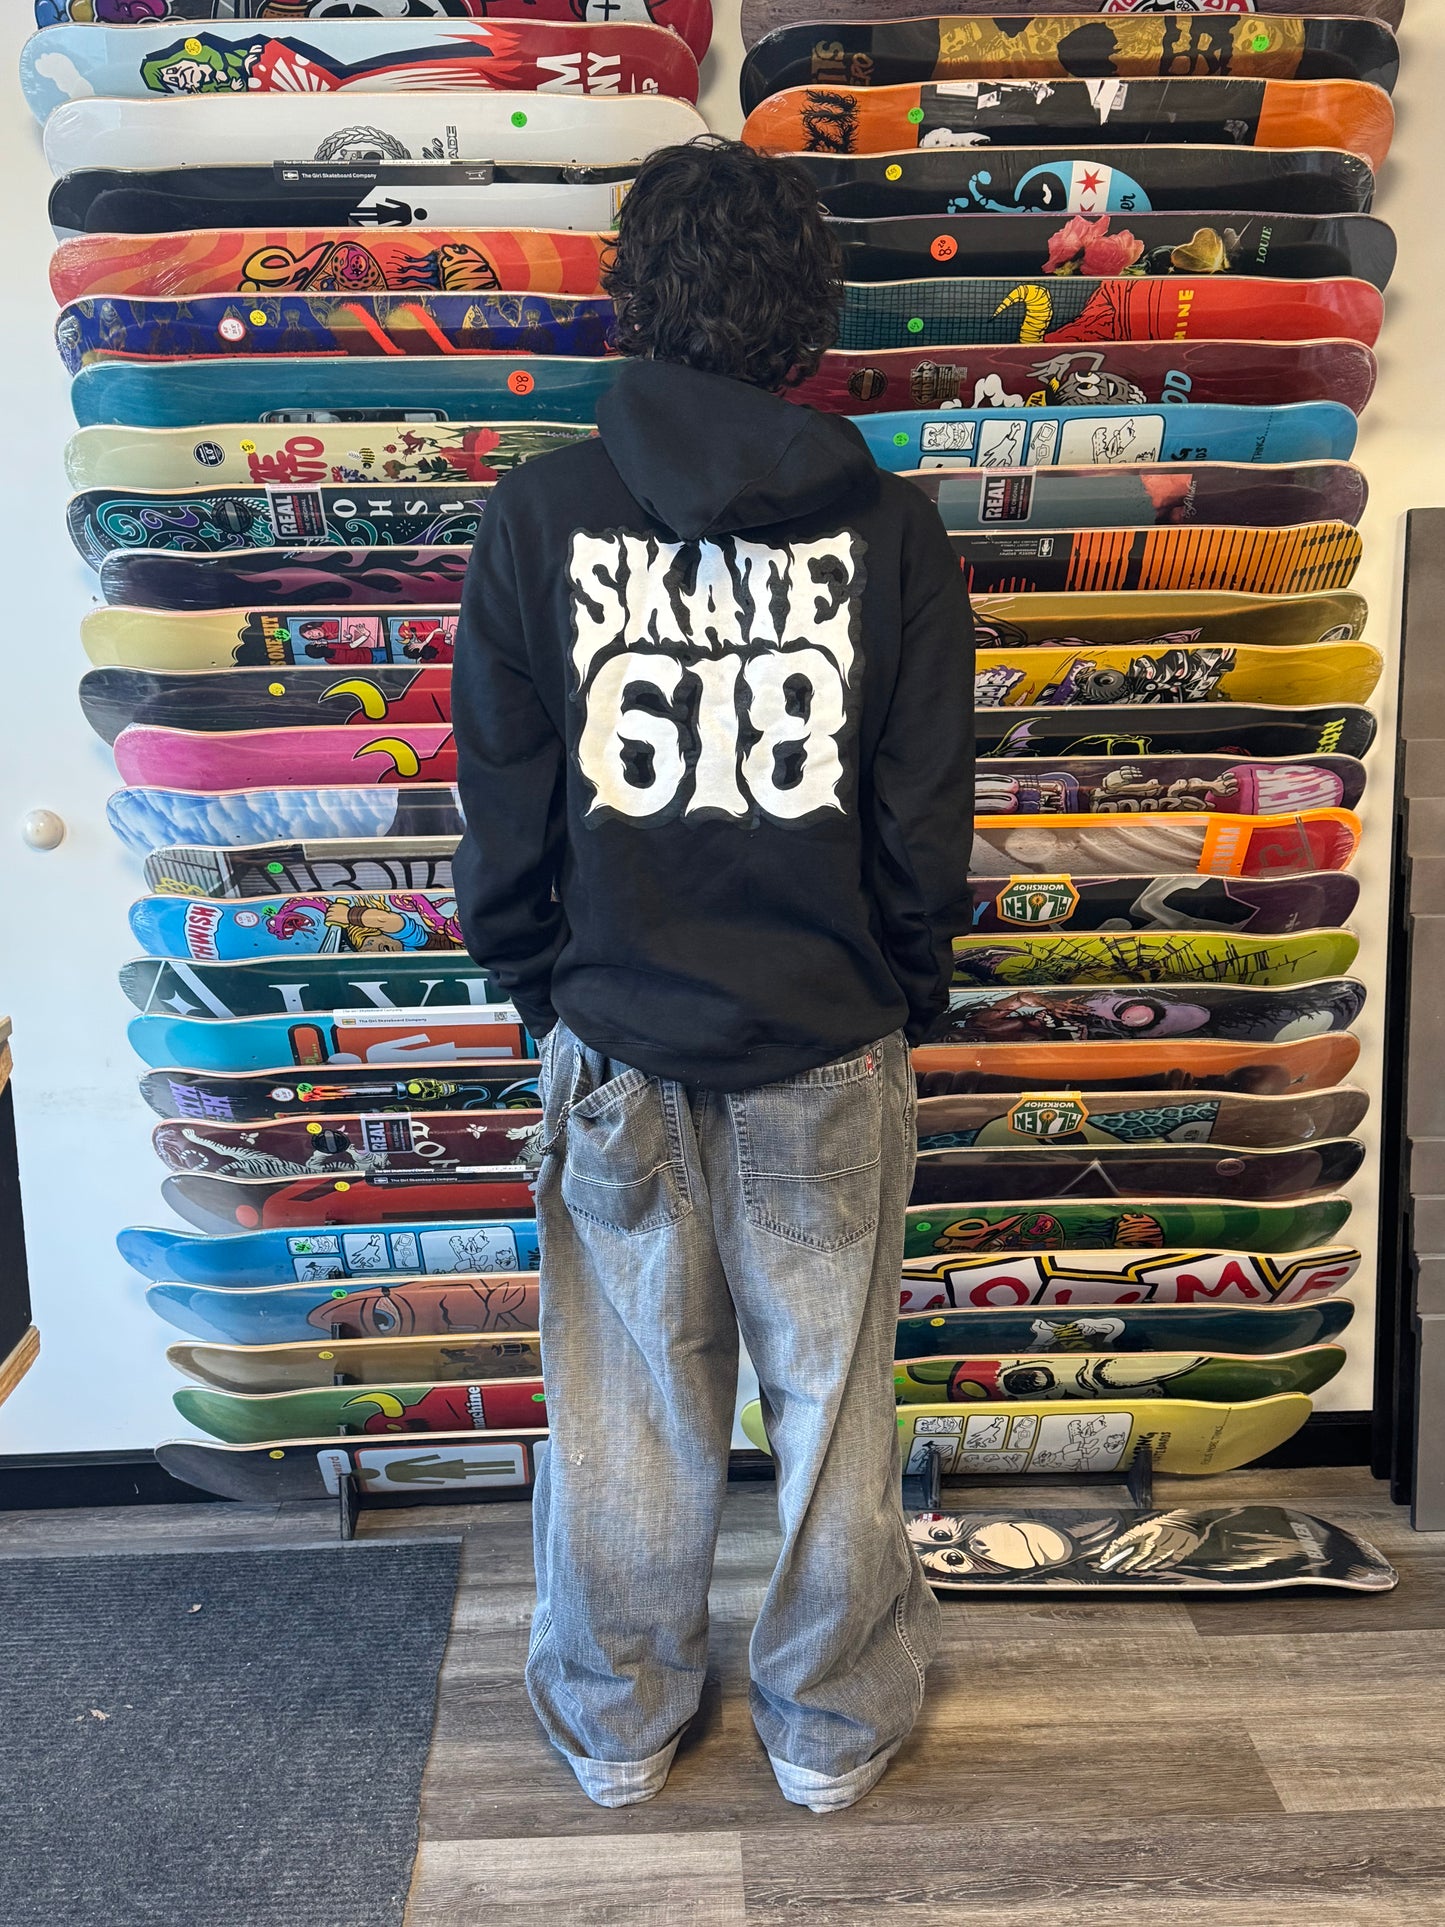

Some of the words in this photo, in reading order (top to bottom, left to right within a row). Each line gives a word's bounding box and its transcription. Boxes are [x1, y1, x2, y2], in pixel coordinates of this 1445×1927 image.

[302, 172, 312, 180] The
[322, 172, 353, 180] Skateboard
[353, 172, 377, 180] Company
[1256, 226, 1273, 264] LOUIE
[515, 375, 530, 393] 8.0
[986, 479, 1006, 519] REAL
[275, 495, 292, 535] REAL
[569, 531, 855, 692] SKATE
[266, 637, 285, 660] ONE
[578, 648, 848, 820] 618
[1013, 883, 1064, 891] WORKSHOP
[1005, 893, 1072, 921] ALIEN
[1015, 1109, 1080, 1133] ALIEN
[368, 1122, 387, 1151] REAL
[466, 1385, 481, 1430] machine
